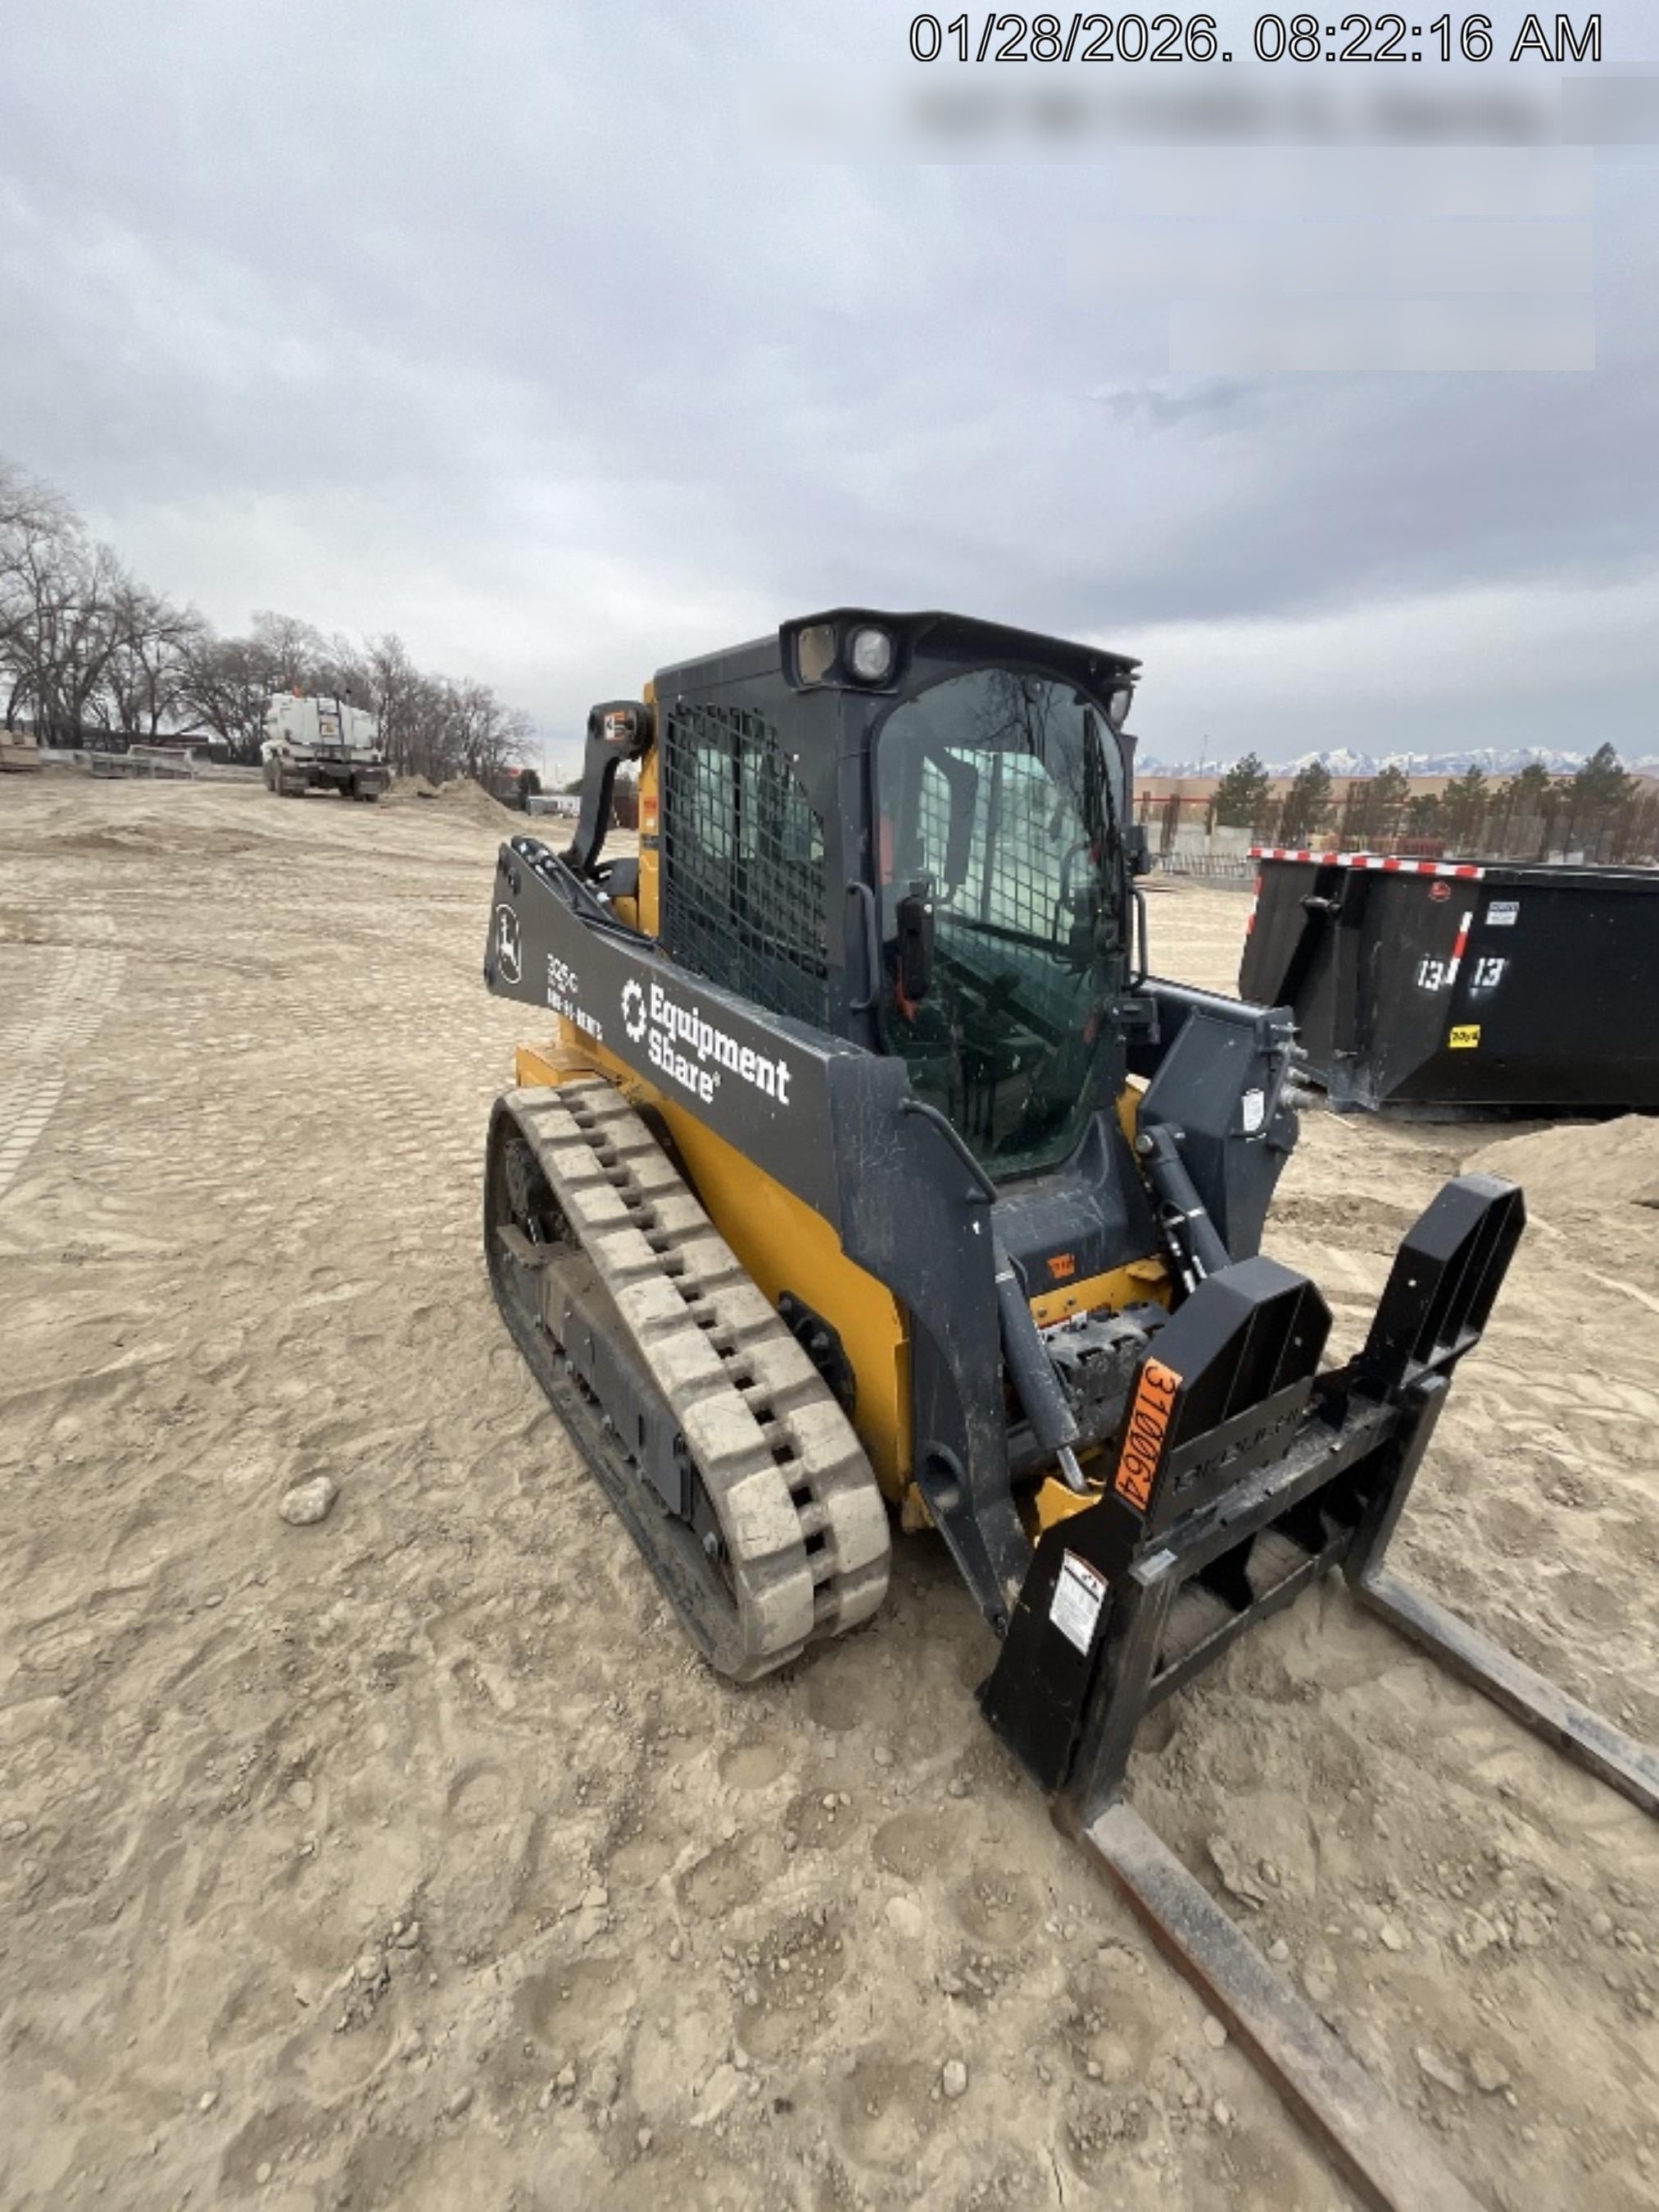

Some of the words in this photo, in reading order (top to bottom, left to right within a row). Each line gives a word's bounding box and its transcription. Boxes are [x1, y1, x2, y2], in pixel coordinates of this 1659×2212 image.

[1418, 959, 1444, 991] 13
[1474, 957, 1506, 987] 13
[650, 982, 792, 1105] Equipment
[1119, 1365, 1176, 1503] 310064
